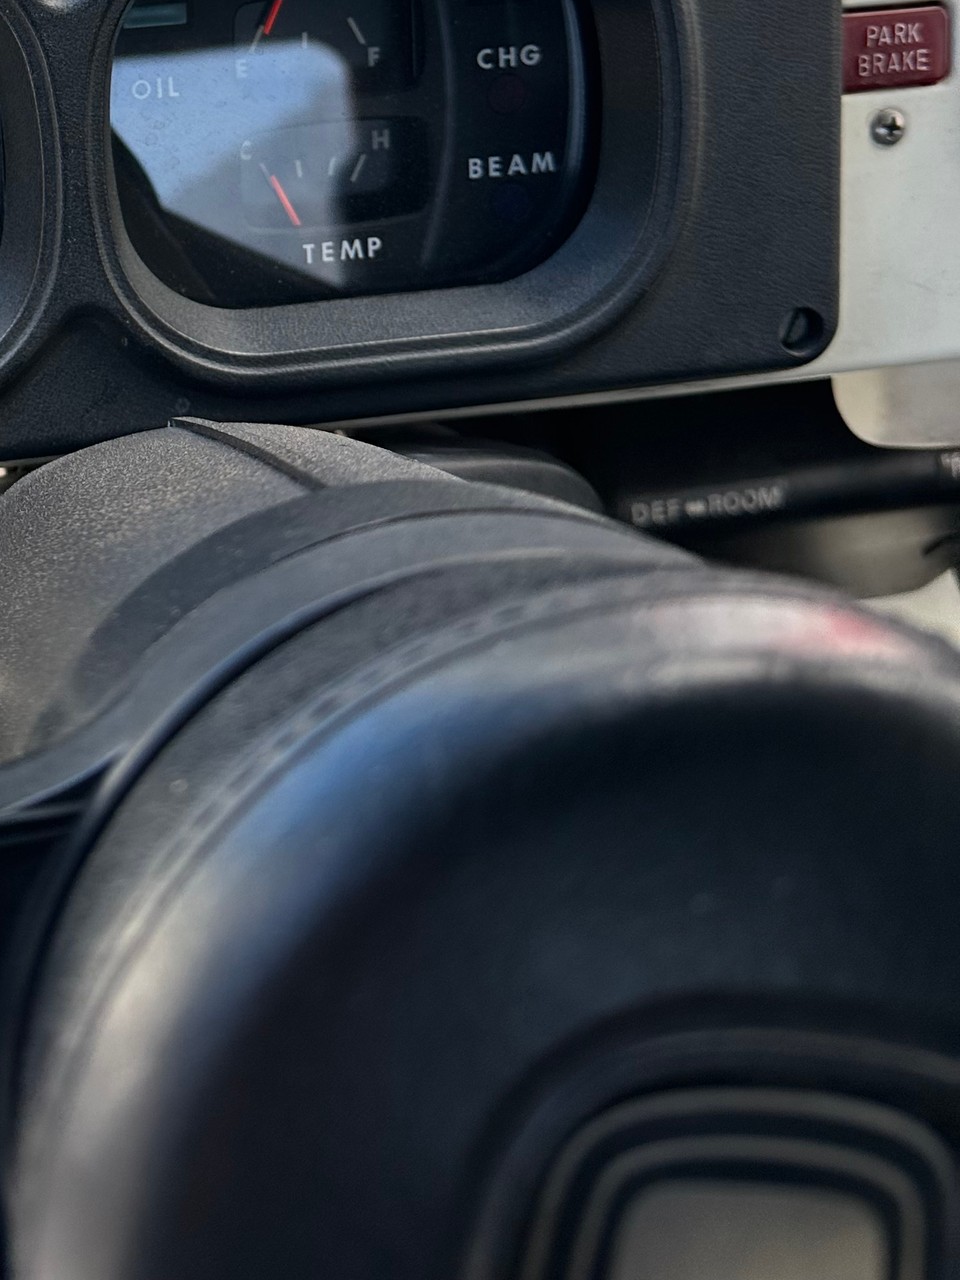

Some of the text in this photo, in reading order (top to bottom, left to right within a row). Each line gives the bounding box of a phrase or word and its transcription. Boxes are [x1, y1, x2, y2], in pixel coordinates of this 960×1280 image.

[866, 23, 922, 48] PARK
[367, 46, 381, 67] F
[477, 44, 542, 69] CHG
[858, 49, 931, 77] BRAKE
[132, 77, 180, 99] OIL
[371, 129, 390, 149] H
[468, 152, 556, 179] BEAM
[303, 237, 383, 264] TEMP
[631, 486, 784, 524] DEF ROOM
